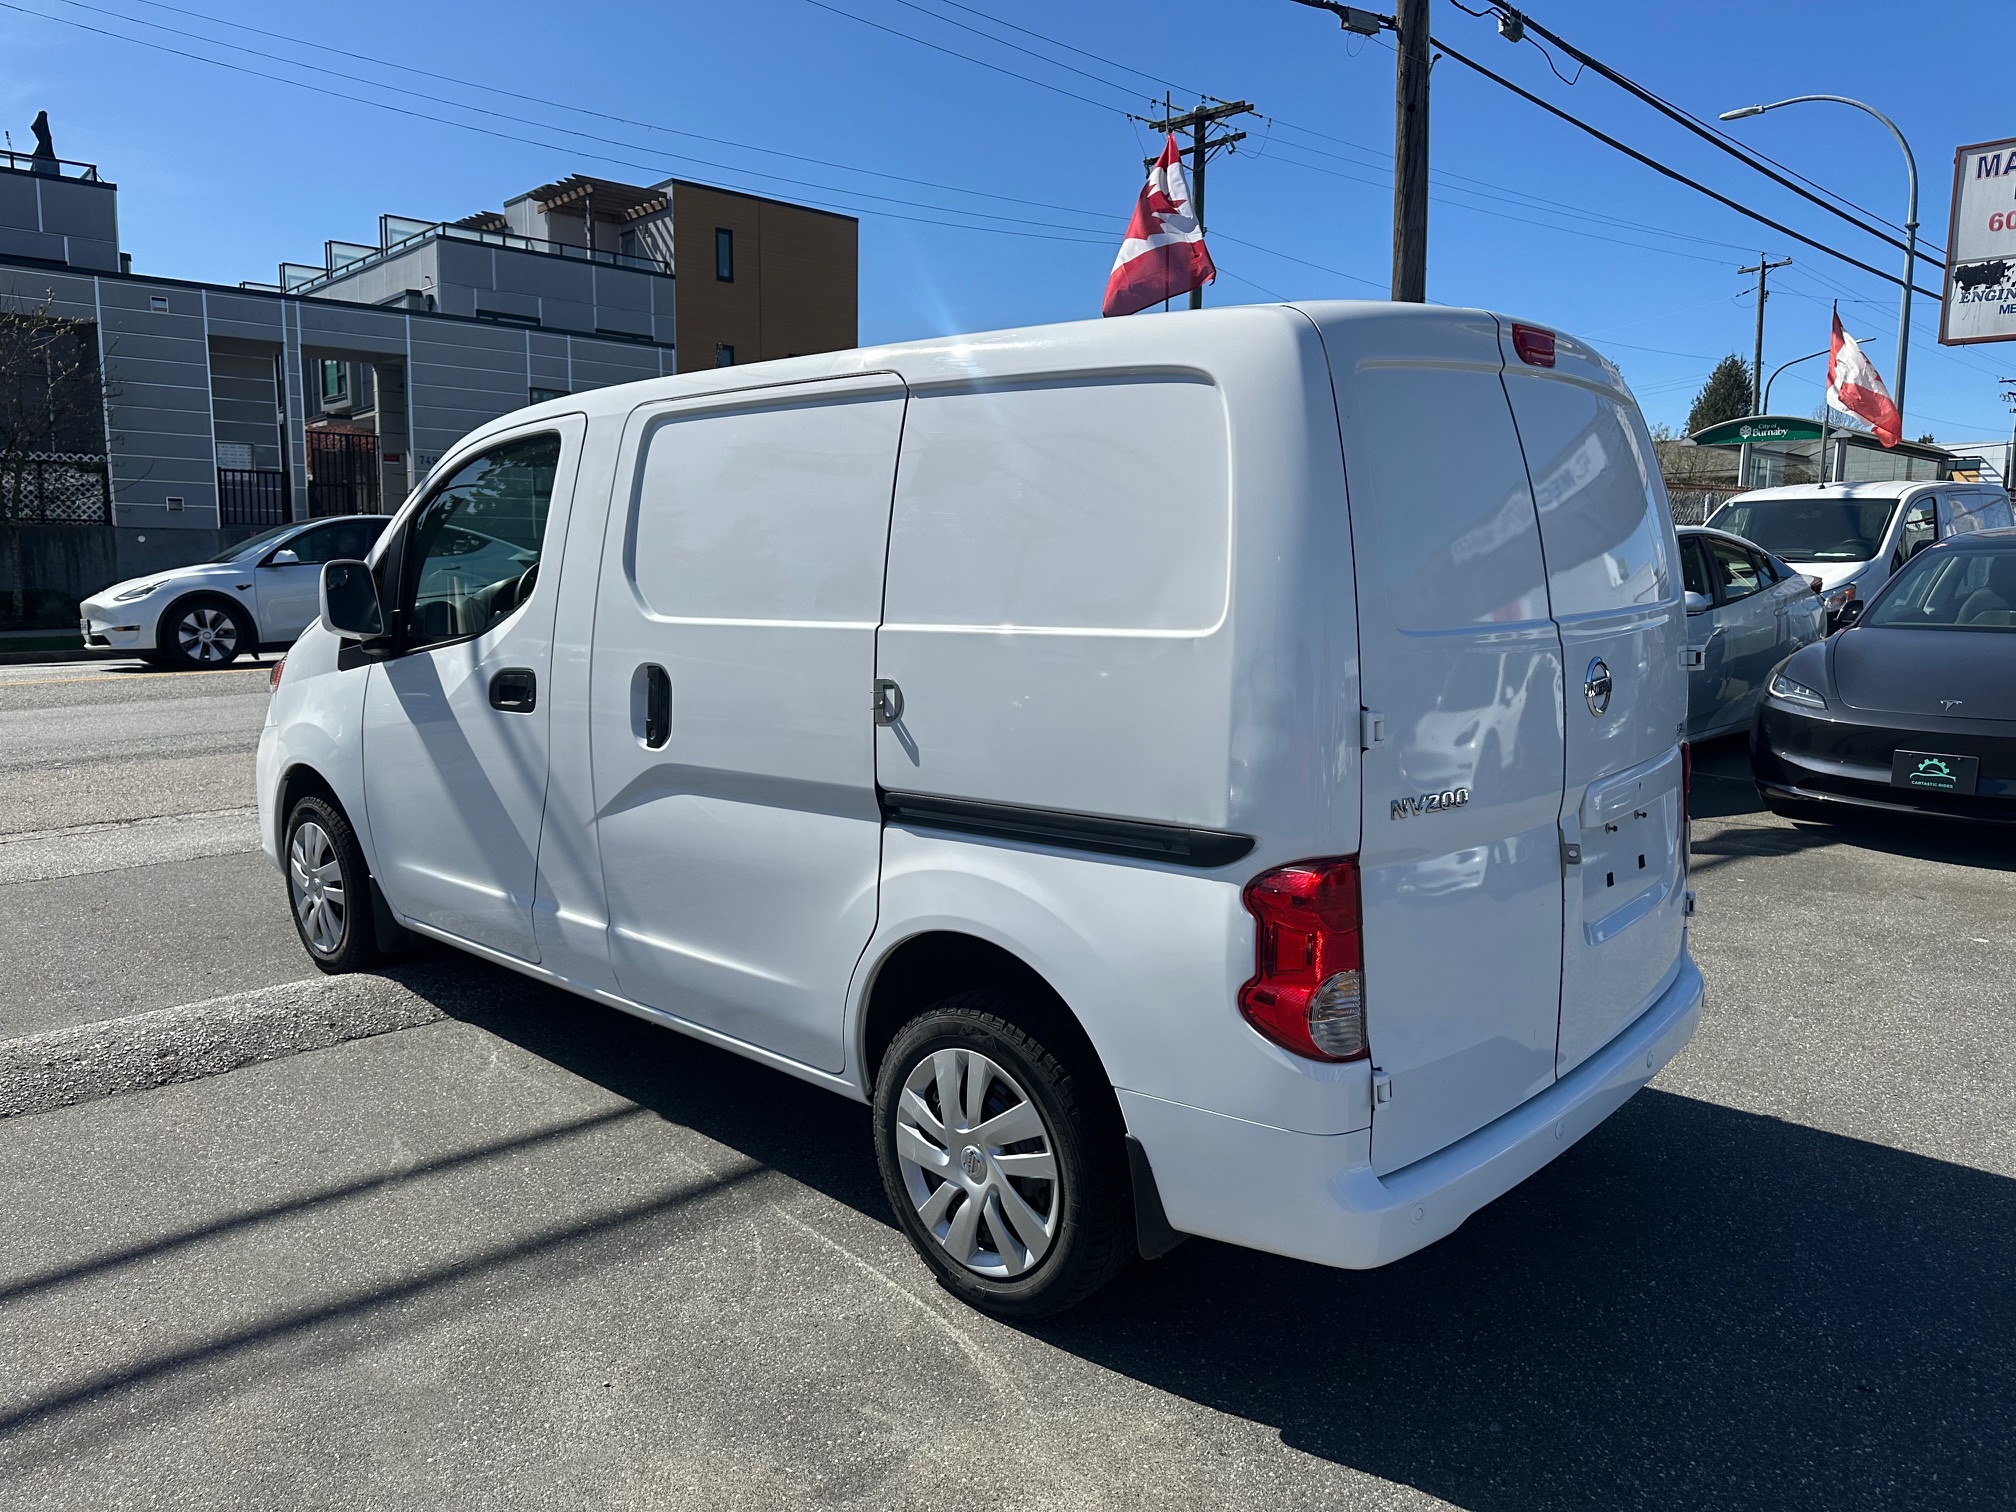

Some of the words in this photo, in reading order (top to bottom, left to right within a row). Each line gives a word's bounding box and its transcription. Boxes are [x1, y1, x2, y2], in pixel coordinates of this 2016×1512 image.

[1988, 211, 2016, 232] 60
[1752, 427, 1788, 437] Burnaby
[1391, 787, 1468, 820] NV200
